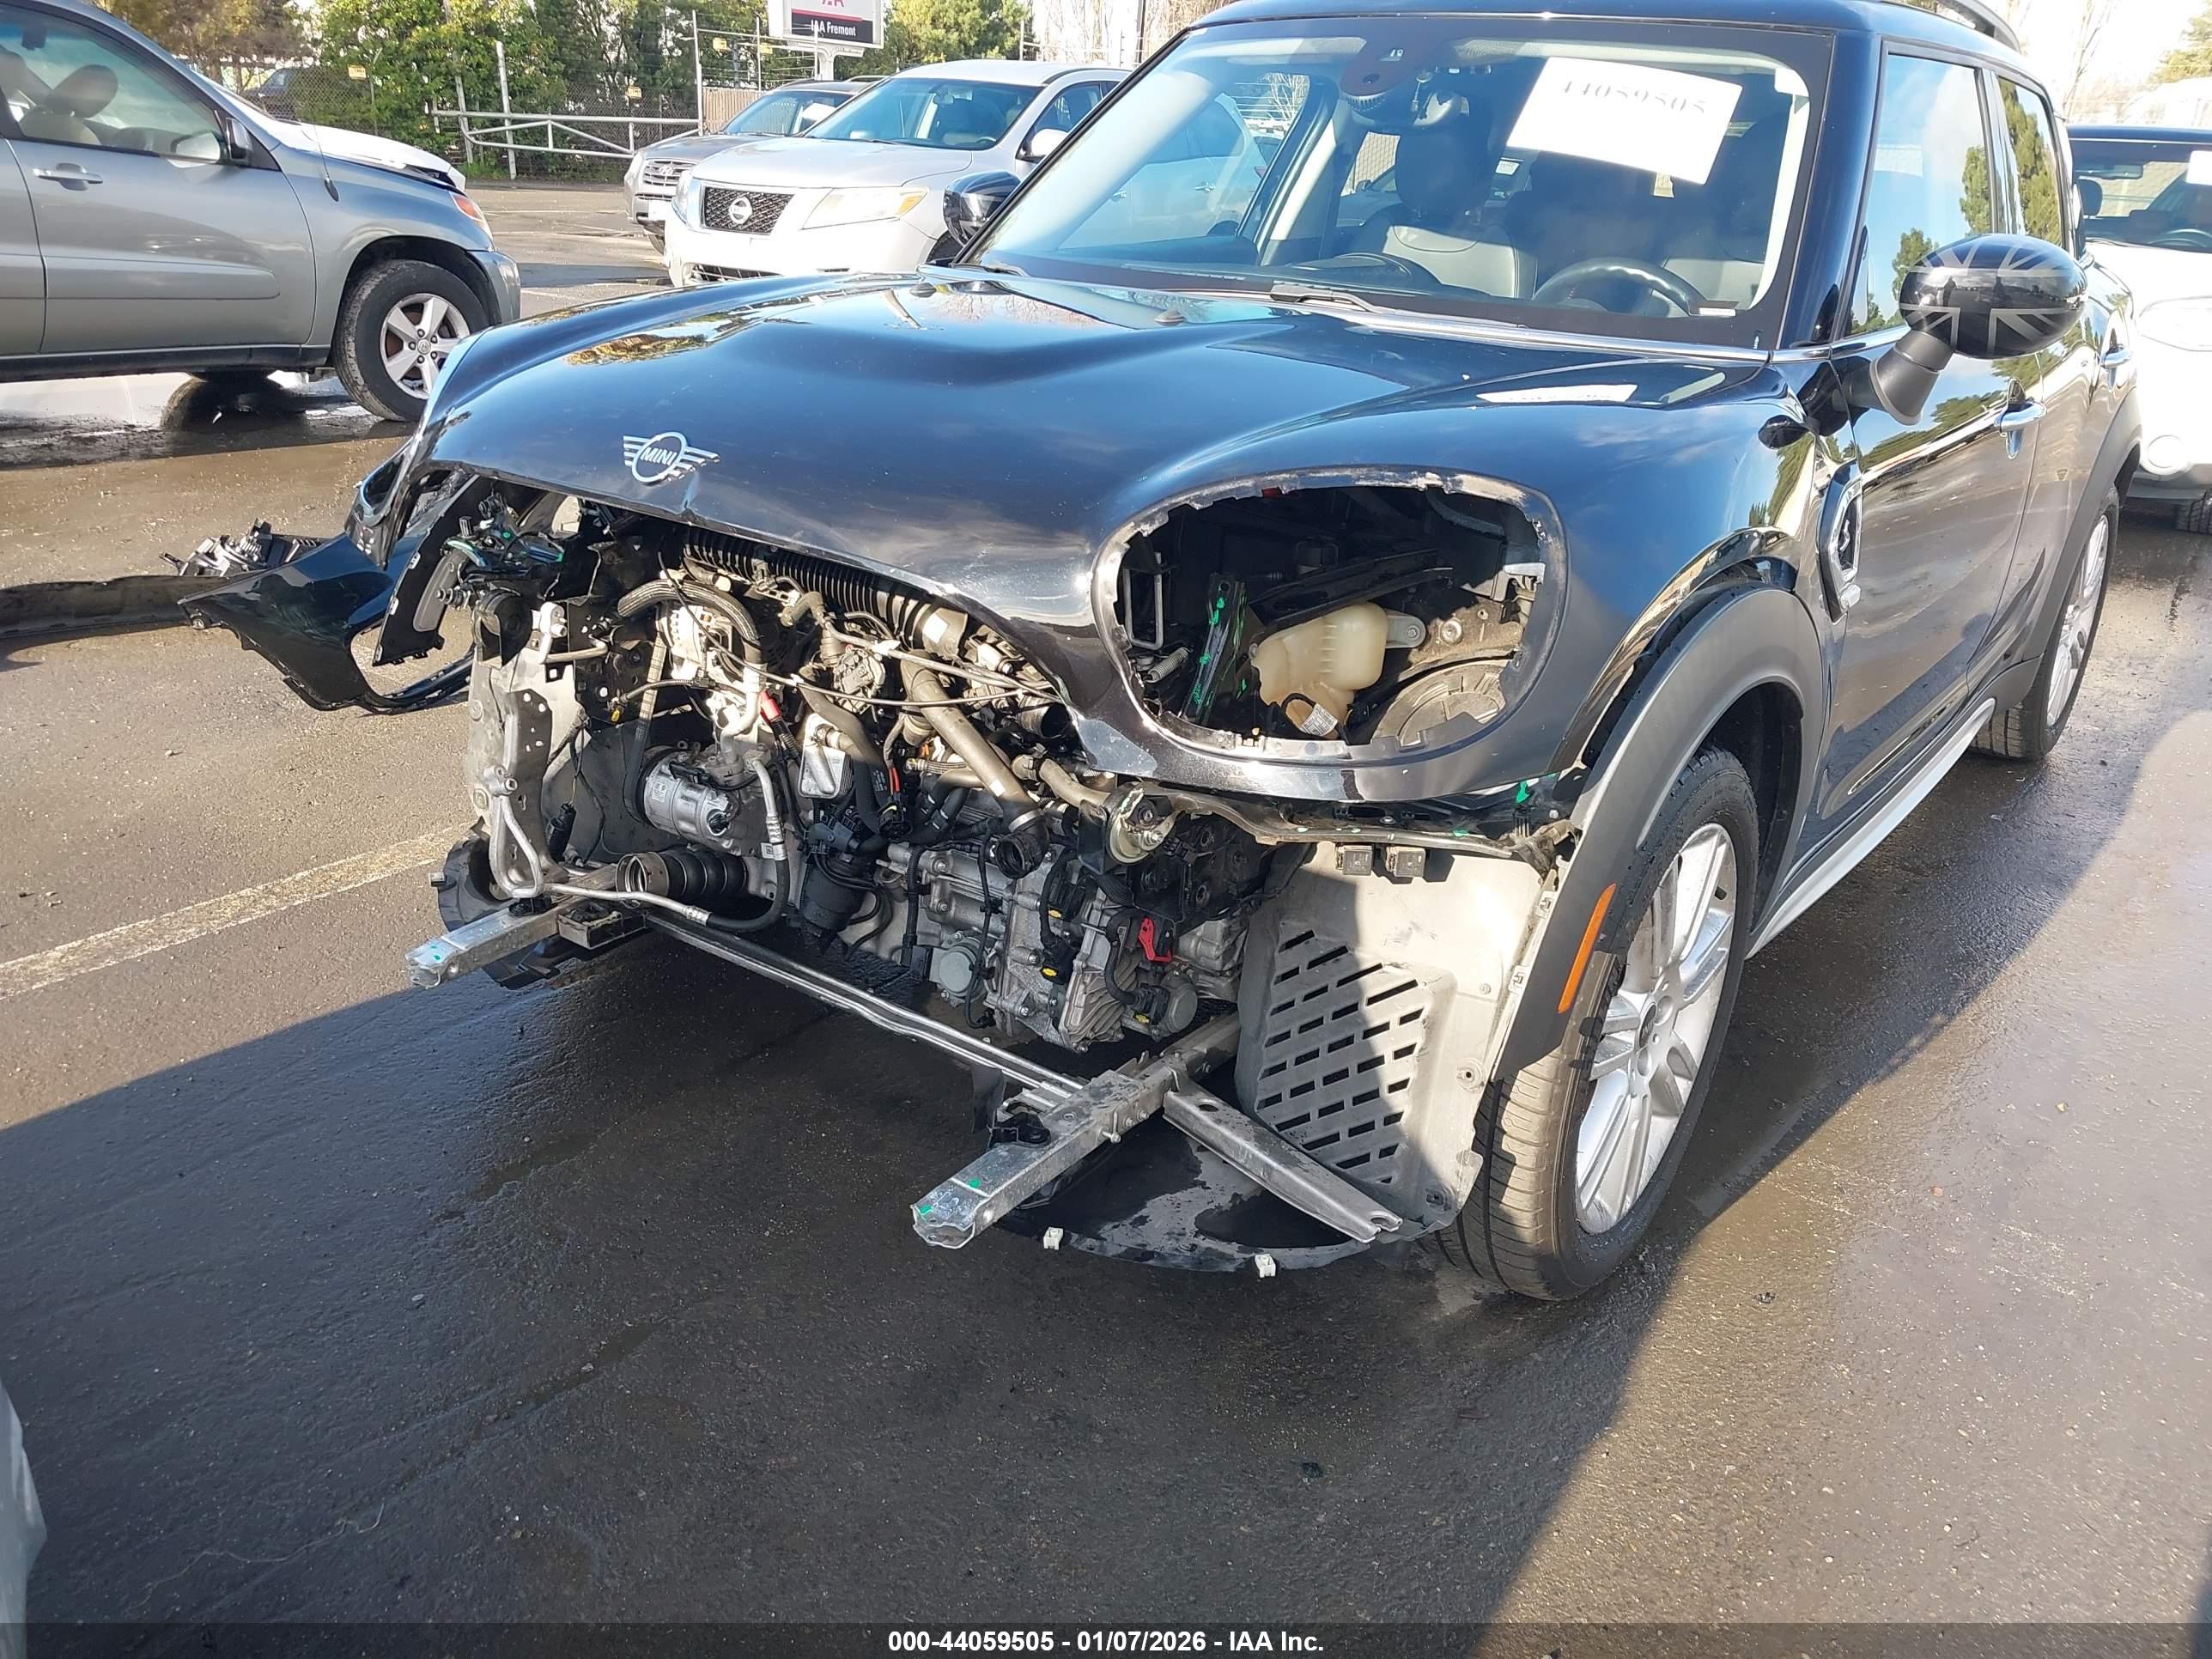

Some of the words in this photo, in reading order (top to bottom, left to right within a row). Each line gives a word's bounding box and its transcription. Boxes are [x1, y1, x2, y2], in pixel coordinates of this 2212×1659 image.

[811, 19, 825, 33] IAA
[826, 21, 856, 36] Fremont
[641, 447, 678, 466] MINI
